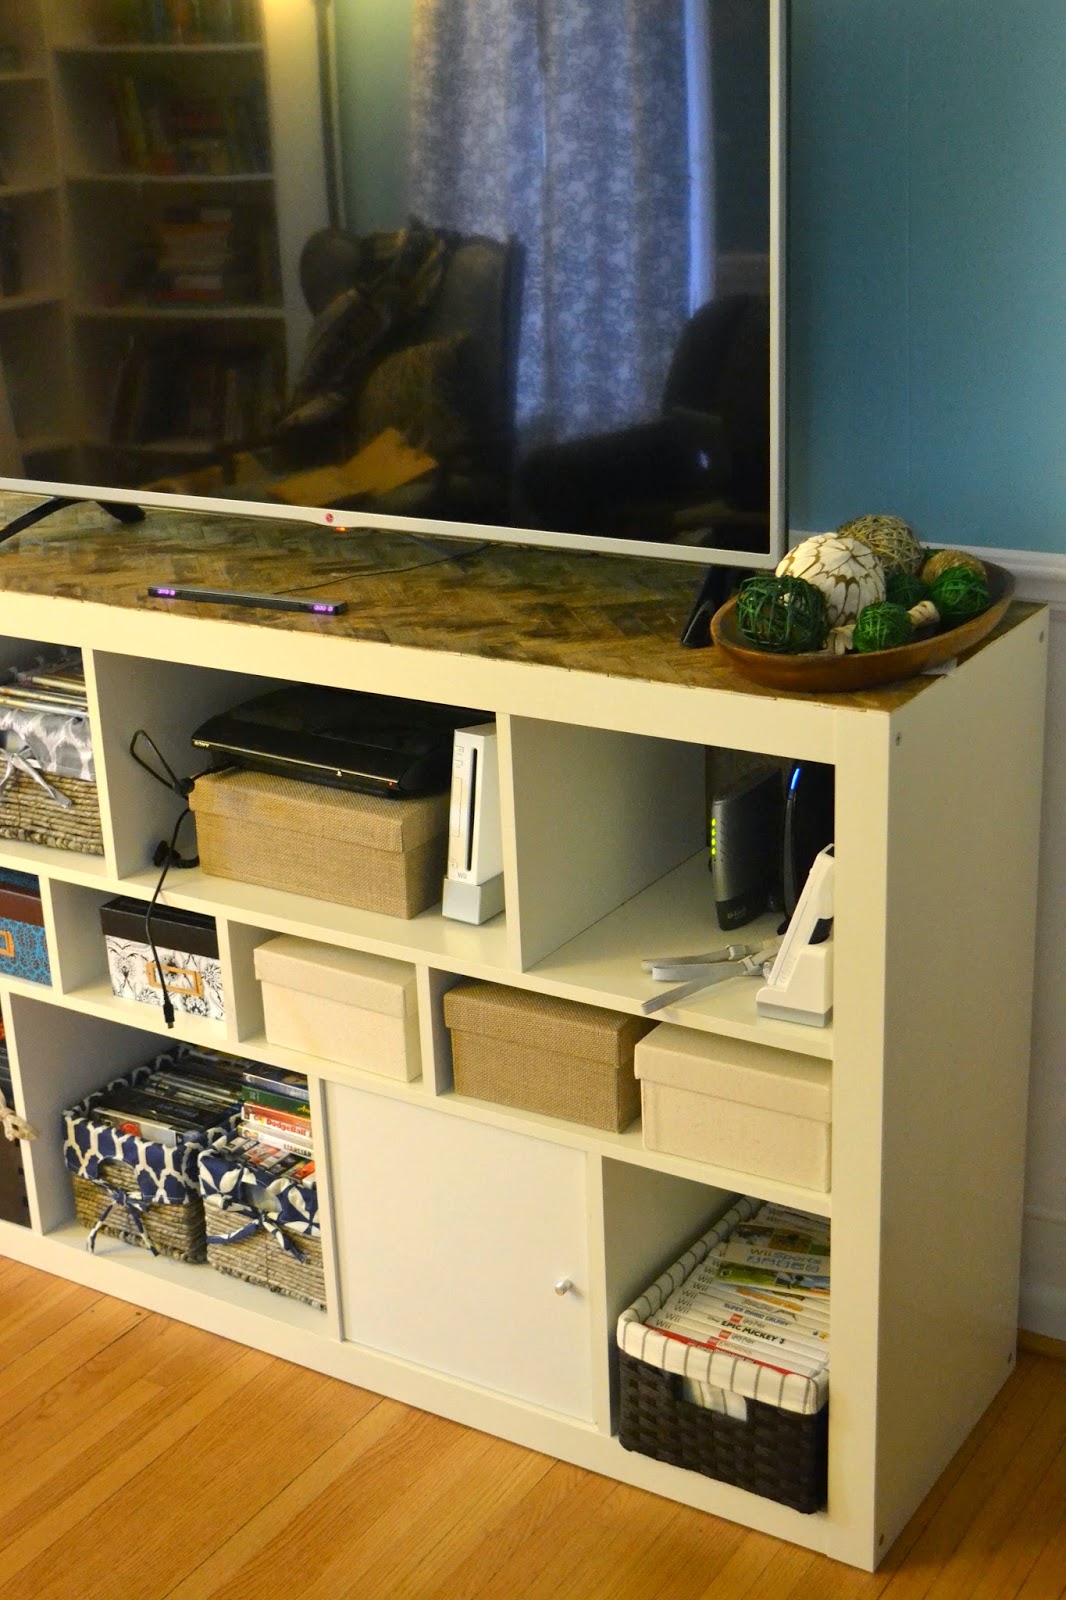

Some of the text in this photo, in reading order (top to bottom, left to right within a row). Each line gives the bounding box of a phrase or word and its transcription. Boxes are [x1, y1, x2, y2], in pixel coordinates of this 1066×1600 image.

[750, 1248, 772, 1257] Wii
[697, 1275, 712, 1285] Wii
[693, 1282, 708, 1292] Wii
[681, 1289, 698, 1299] Wii
[677, 1297, 693, 1307] Wii
[674, 1304, 689, 1314] Wii
[724, 1302, 744, 1313] SUPER
[665, 1312, 681, 1323] Wii
[655, 1319, 671, 1330] Wii
[721, 1320, 742, 1331] EPIC
[742, 1326, 778, 1342] MICKEY
